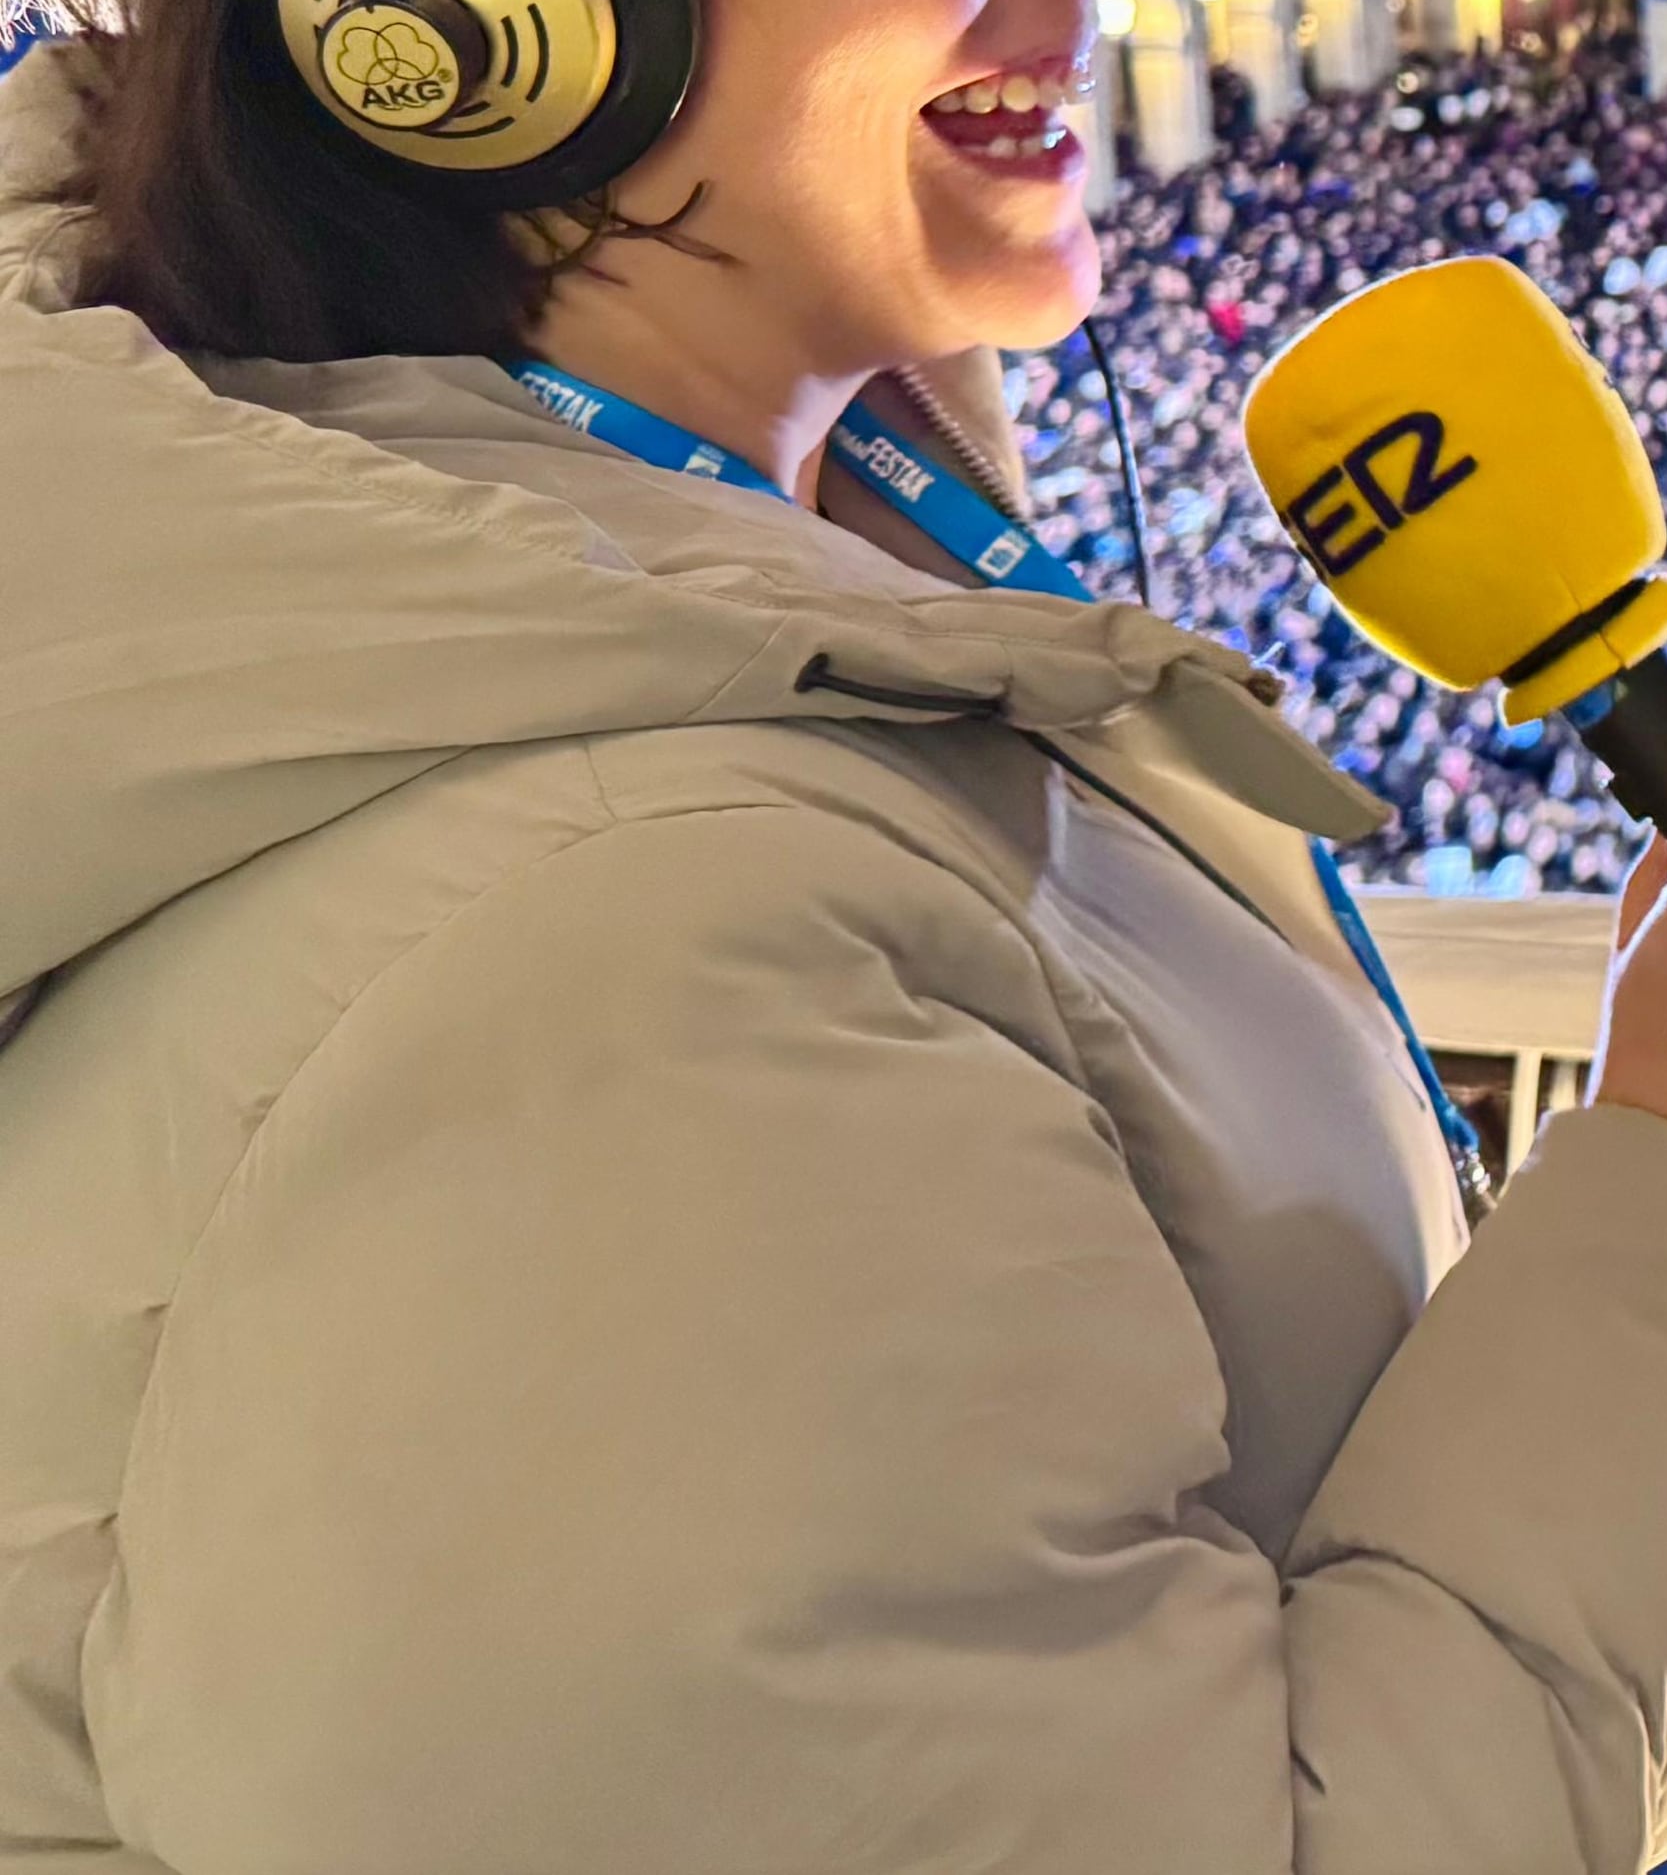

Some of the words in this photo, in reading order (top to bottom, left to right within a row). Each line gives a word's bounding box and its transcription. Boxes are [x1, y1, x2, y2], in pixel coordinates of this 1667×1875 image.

[361, 80, 445, 109] AKG
[867, 435, 936, 503] FESTAK
[1280, 410, 1479, 579] ER
